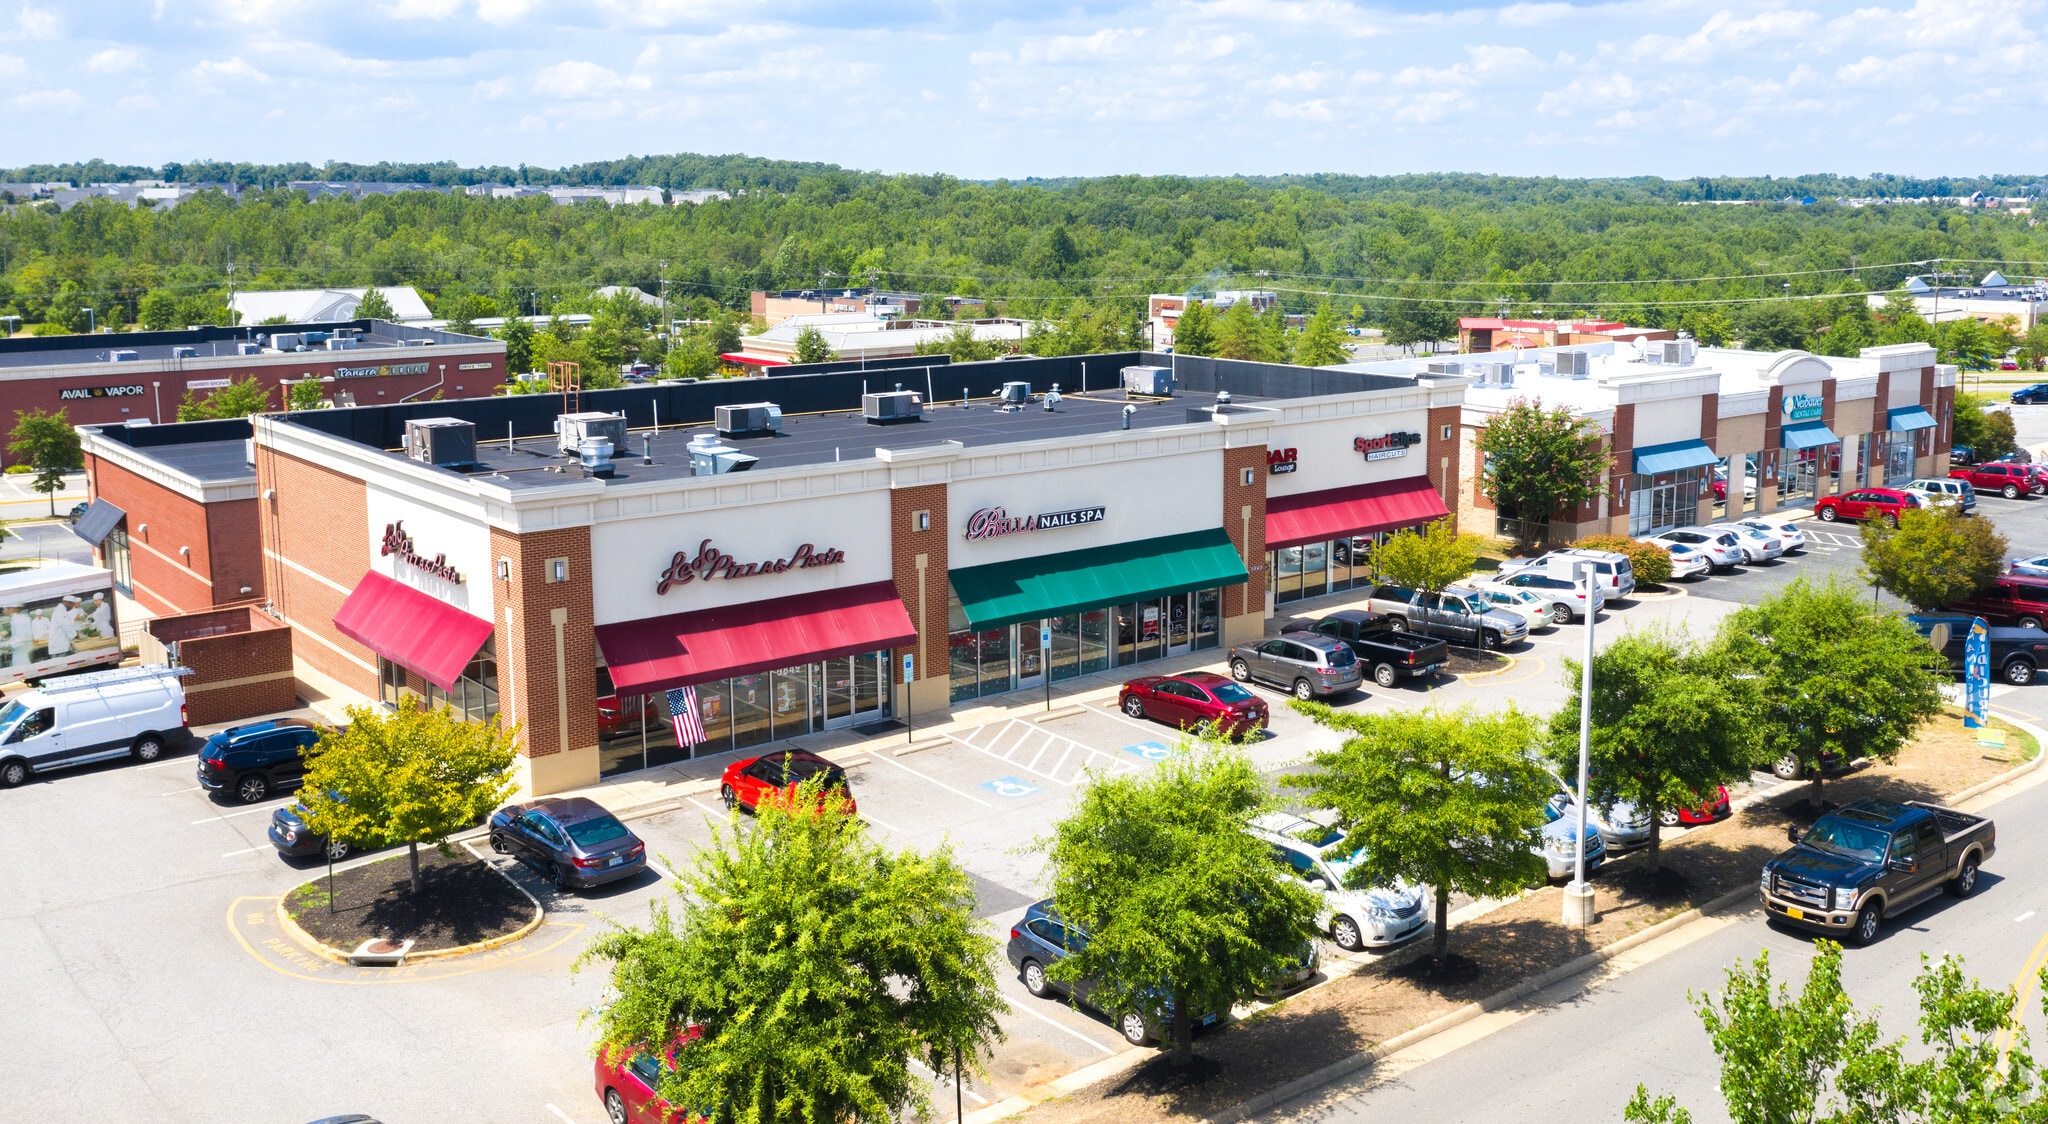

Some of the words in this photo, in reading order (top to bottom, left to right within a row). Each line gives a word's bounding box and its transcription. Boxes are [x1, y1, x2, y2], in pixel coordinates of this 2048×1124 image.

[337, 367, 377, 377] Panera
[391, 365, 427, 375] BREAD
[61, 388, 92, 400] AVAIL
[105, 385, 144, 397] VAPOR
[1368, 449, 1406, 461] HAIRCUTS
[1274, 463, 1295, 473] Lounge
[1041, 512, 1077, 529] NAILS
[1080, 509, 1103, 523] SPA
[381, 519, 407, 557] Ledo
[656, 538, 720, 596] Ledo
[246, 912, 265, 925] NO
[261, 938, 325, 972] PARKING
[356, 968, 420, 978] FIRE
